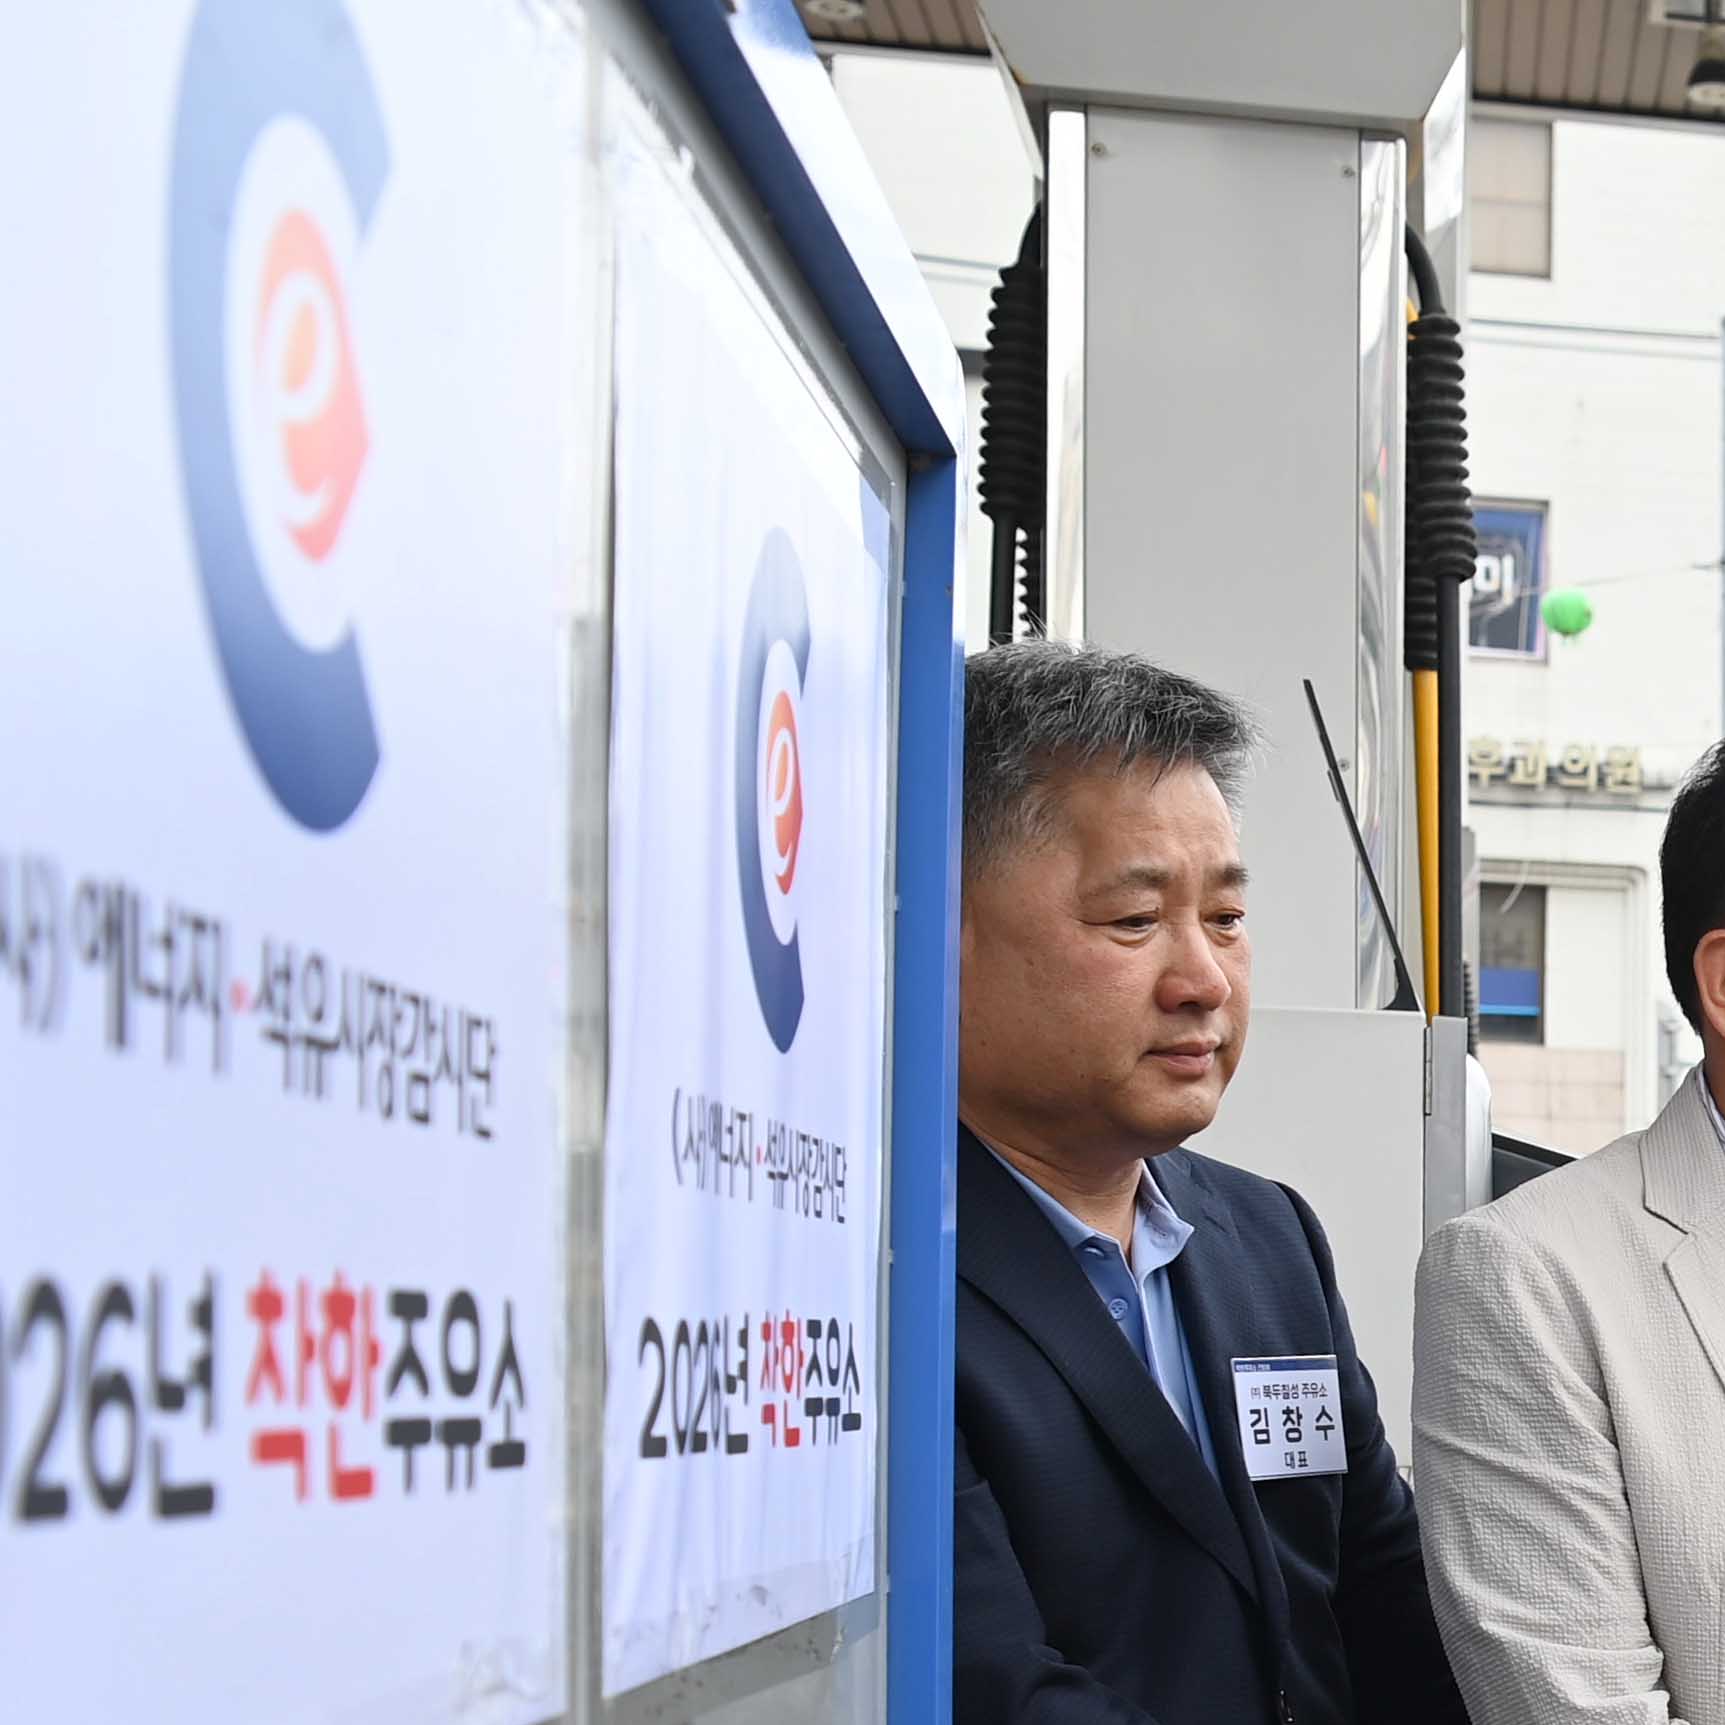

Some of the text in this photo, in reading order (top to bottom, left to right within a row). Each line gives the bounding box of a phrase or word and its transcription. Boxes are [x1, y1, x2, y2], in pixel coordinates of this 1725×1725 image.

[0, 1264, 528, 1524] 26년 착한주유소
[640, 1308, 863, 1460] 2026년 착한주유소
[1301, 1382, 1328, 1399] 주유소
